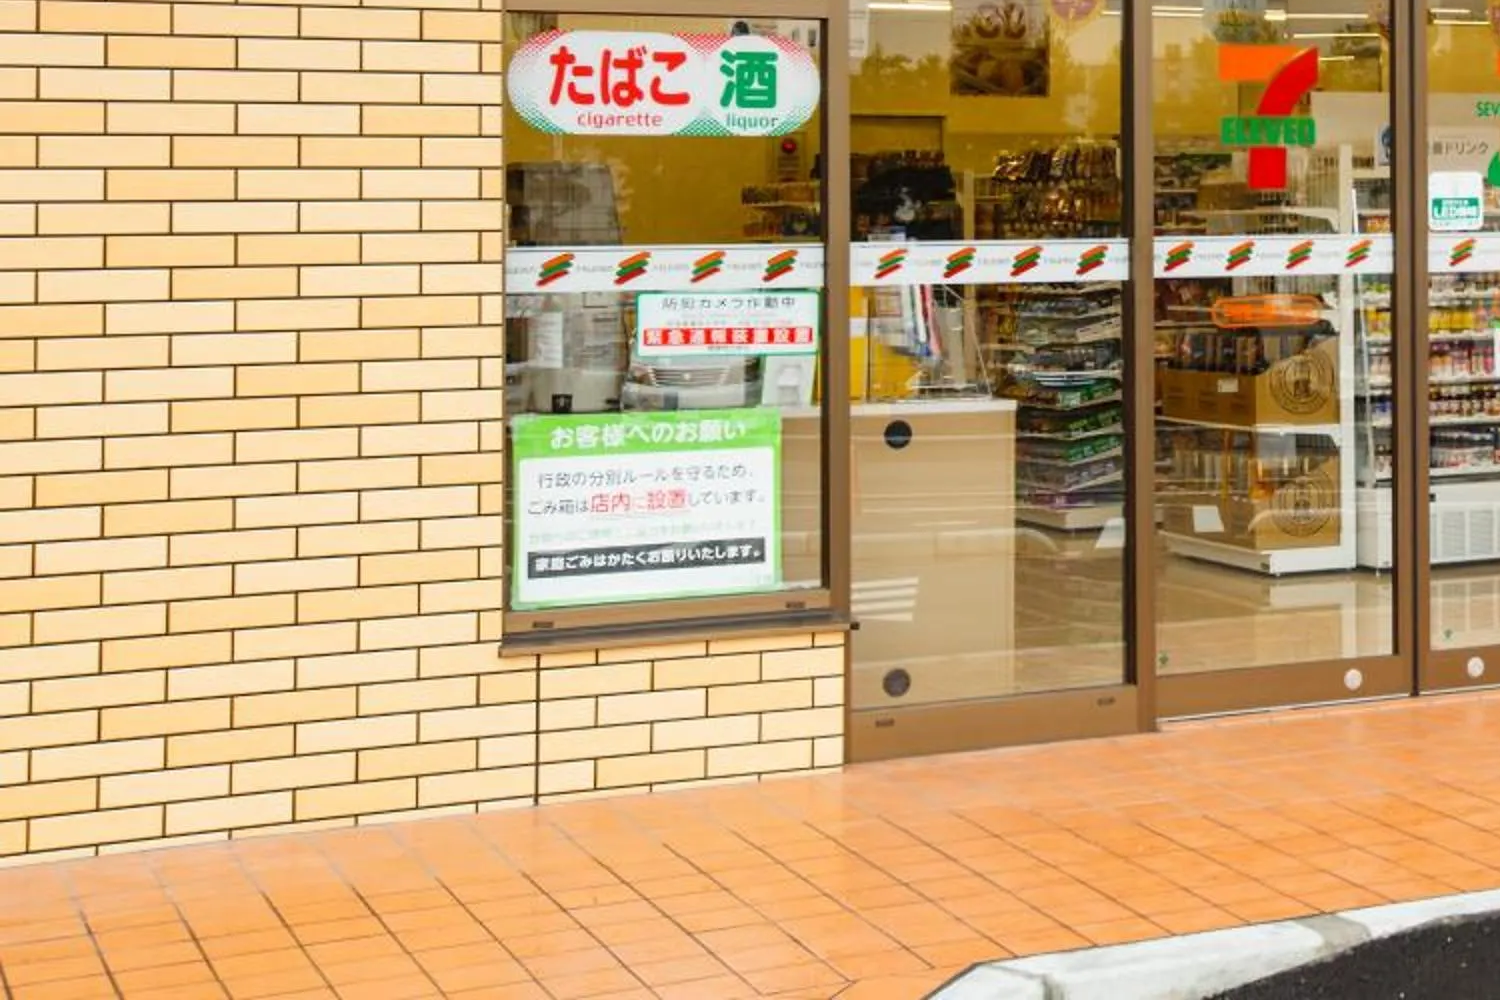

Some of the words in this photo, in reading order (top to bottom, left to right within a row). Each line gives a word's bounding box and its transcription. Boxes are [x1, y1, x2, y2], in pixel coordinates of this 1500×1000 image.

[550, 45, 691, 108] たばこ
[719, 50, 778, 109] 酒
[577, 111, 663, 129] cigarette
[726, 112, 779, 131] liquor
[1432, 140, 1489, 156] ドリンク
[550, 418, 747, 449] お客様へのお願い
